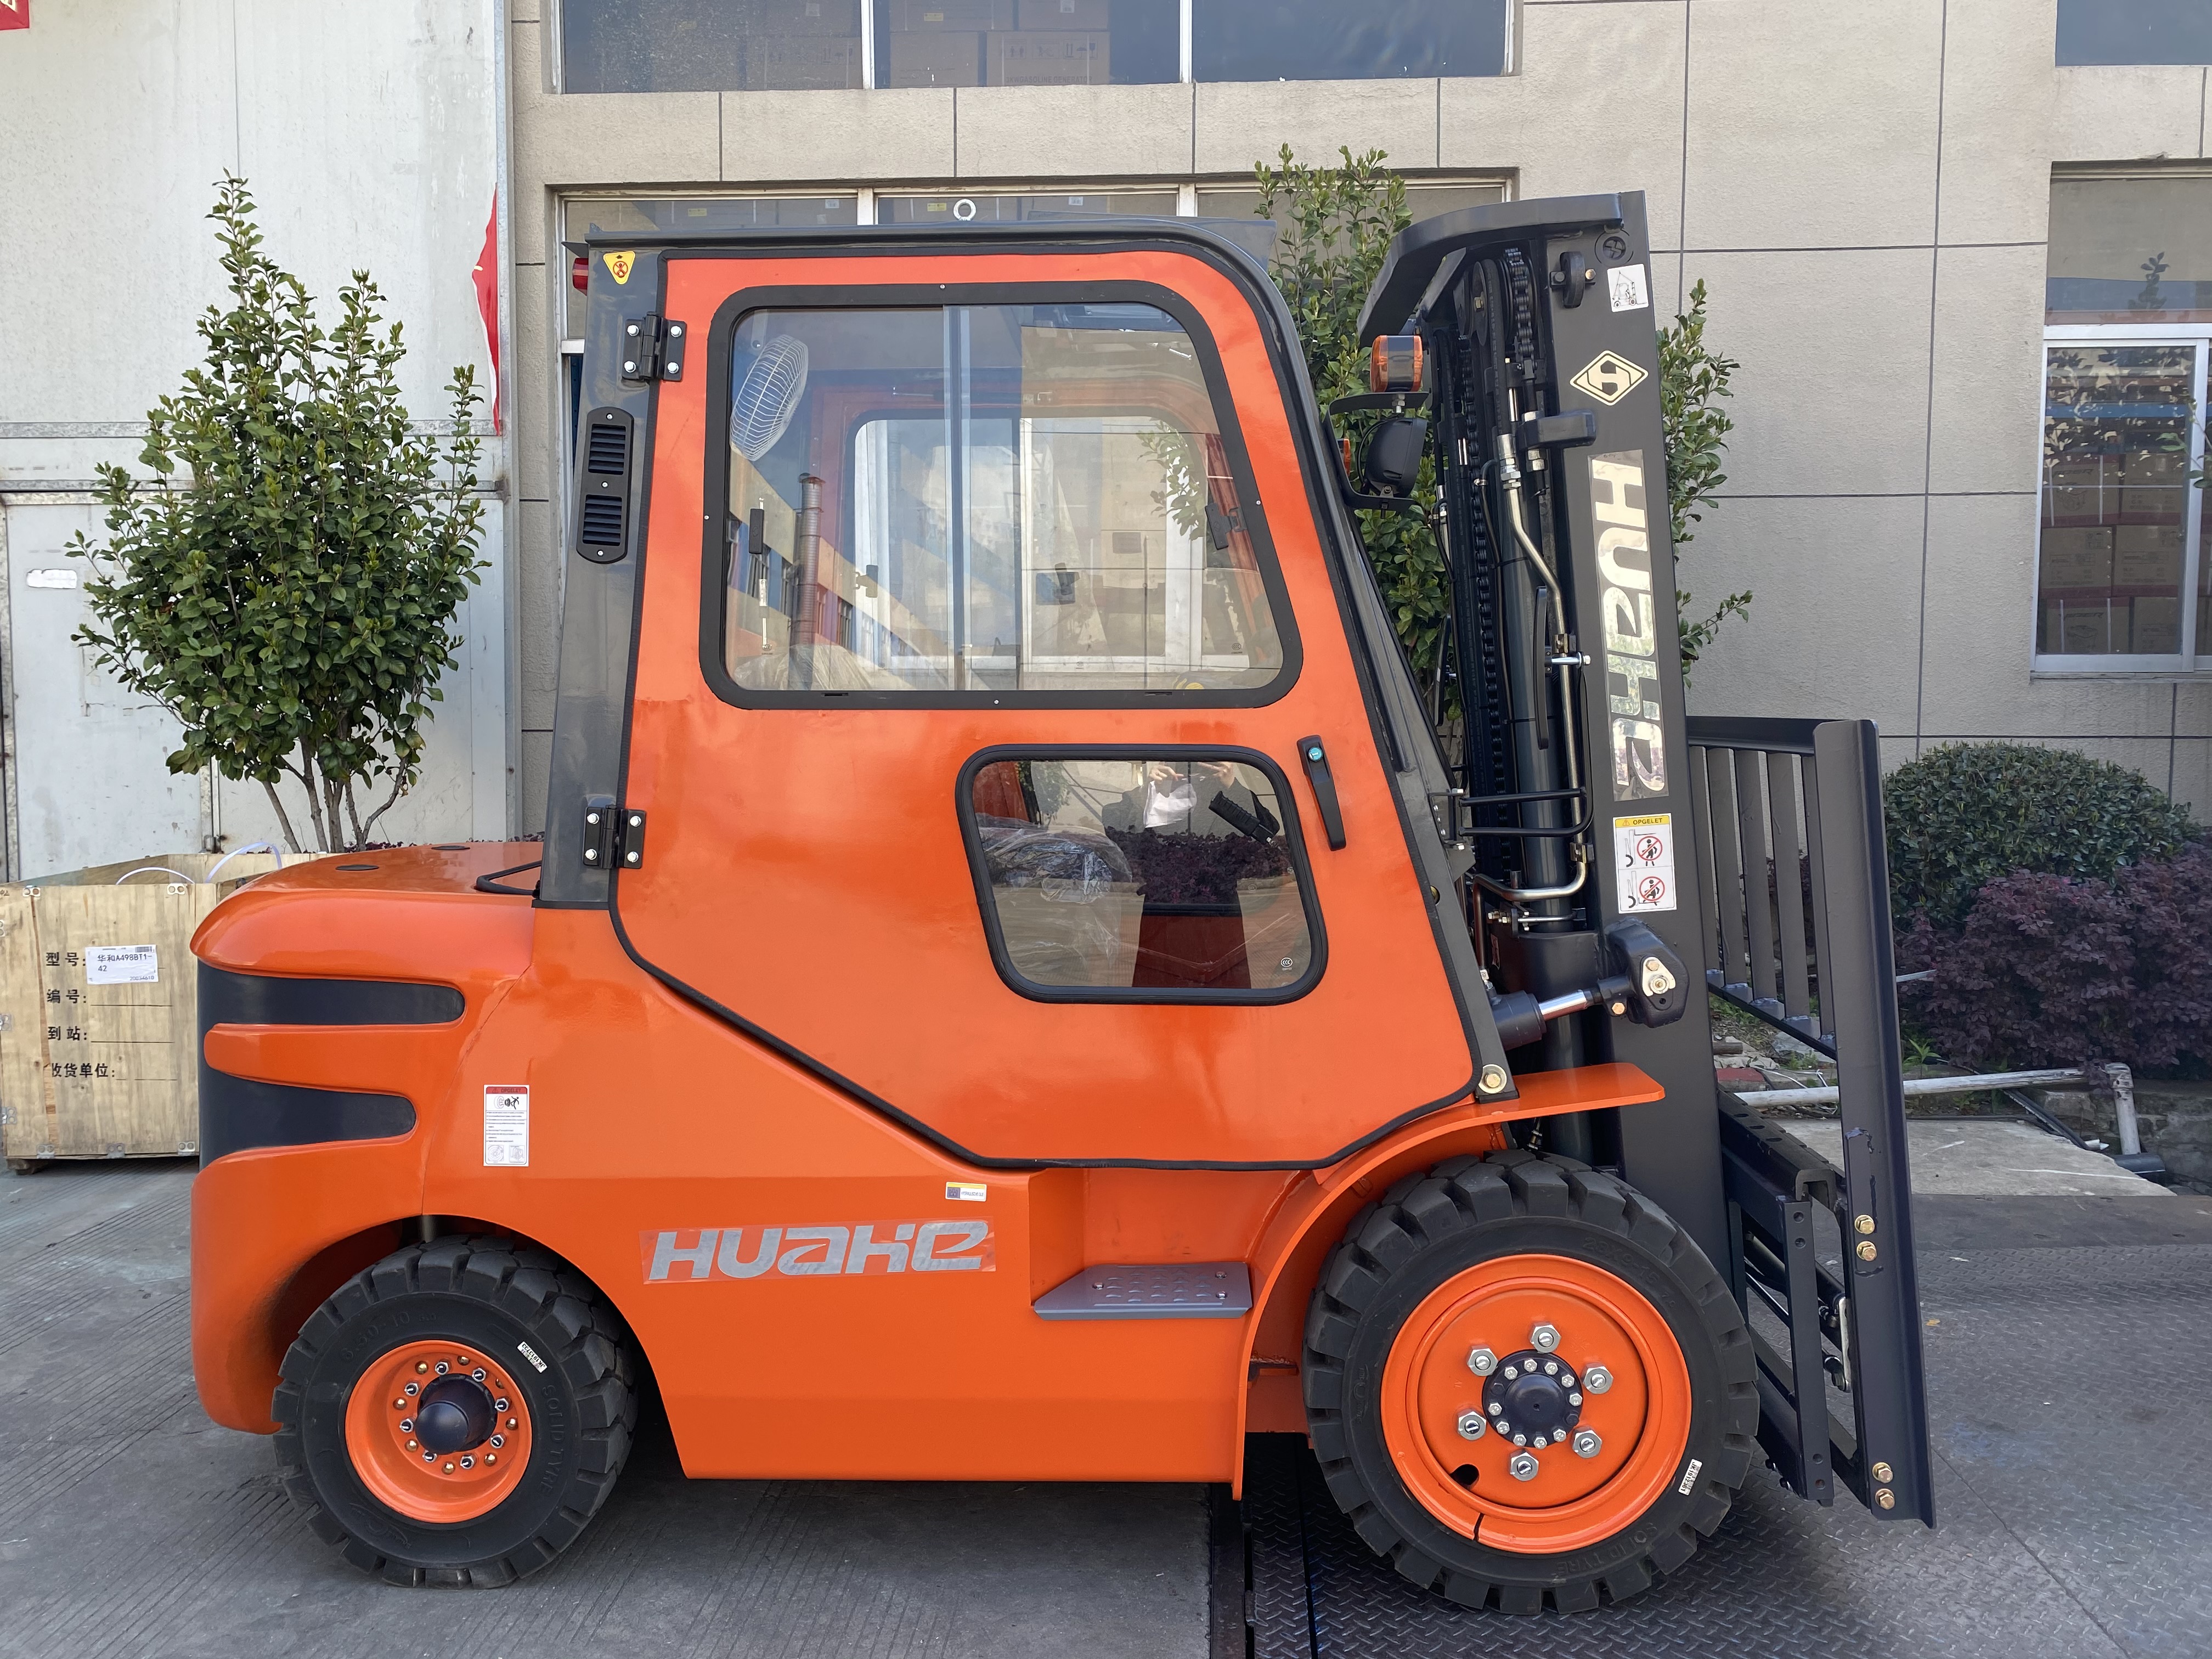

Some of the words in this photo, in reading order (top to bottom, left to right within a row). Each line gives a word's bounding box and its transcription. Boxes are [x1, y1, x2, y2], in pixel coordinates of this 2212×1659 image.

[541, 1384, 565, 1441] SOLID
[1610, 1522, 1657, 1559] SOLID
[1557, 1552, 1606, 1574] TYRE
